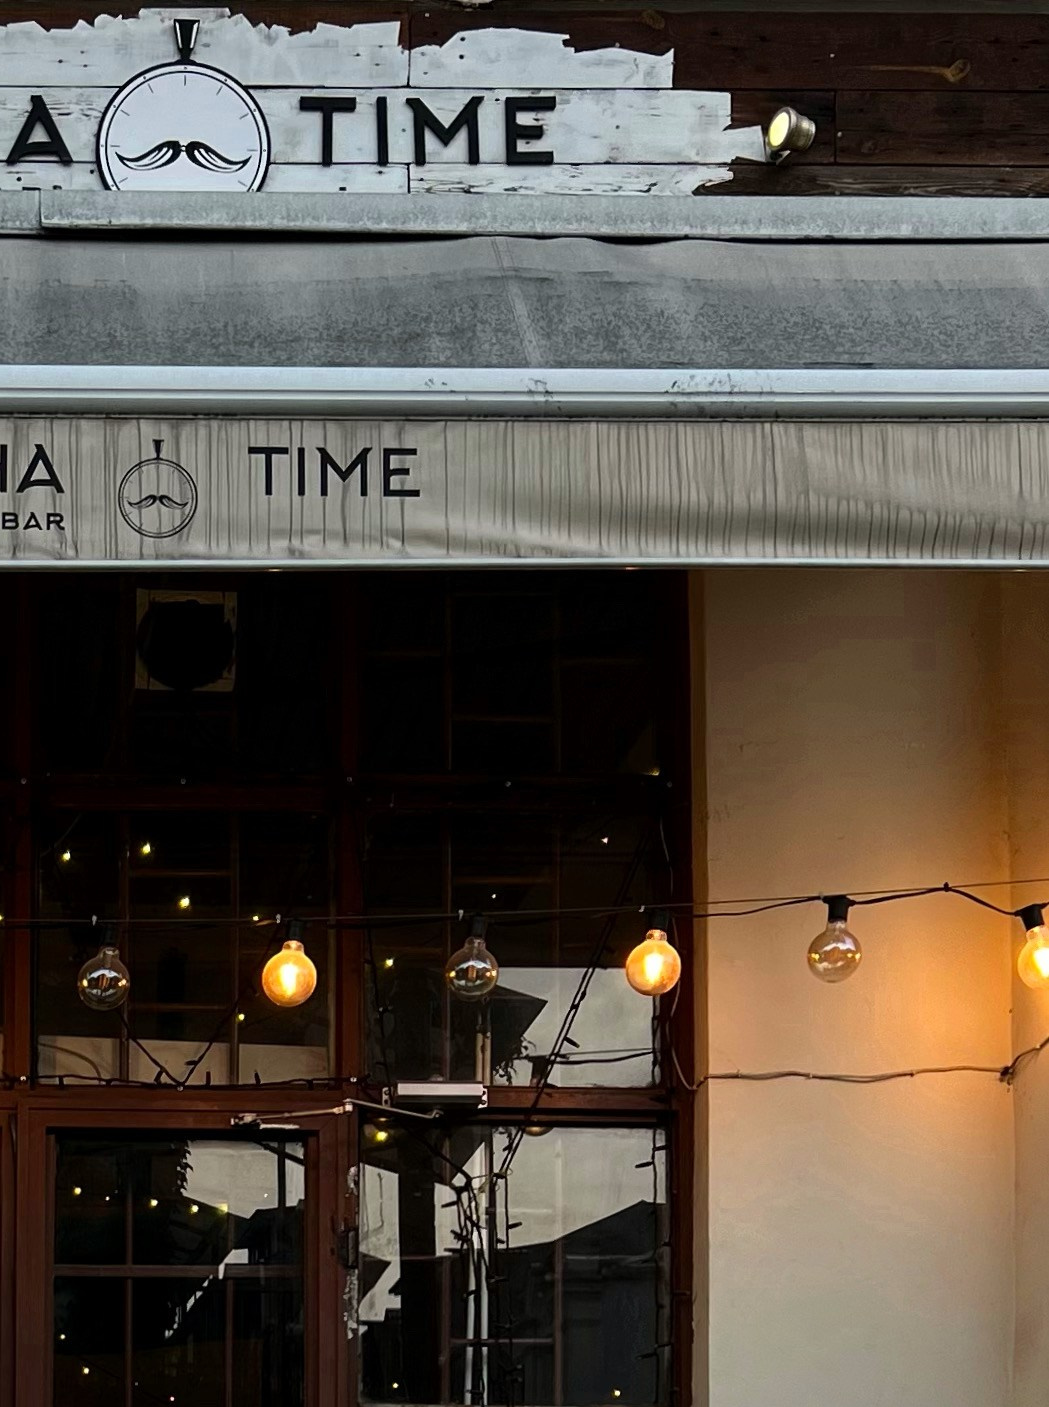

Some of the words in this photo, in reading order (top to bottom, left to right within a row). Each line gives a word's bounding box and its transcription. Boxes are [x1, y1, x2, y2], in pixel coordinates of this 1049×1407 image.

[299, 95, 558, 167] TIME
[248, 445, 420, 498] TIME
[0, 510, 67, 532] BAR
